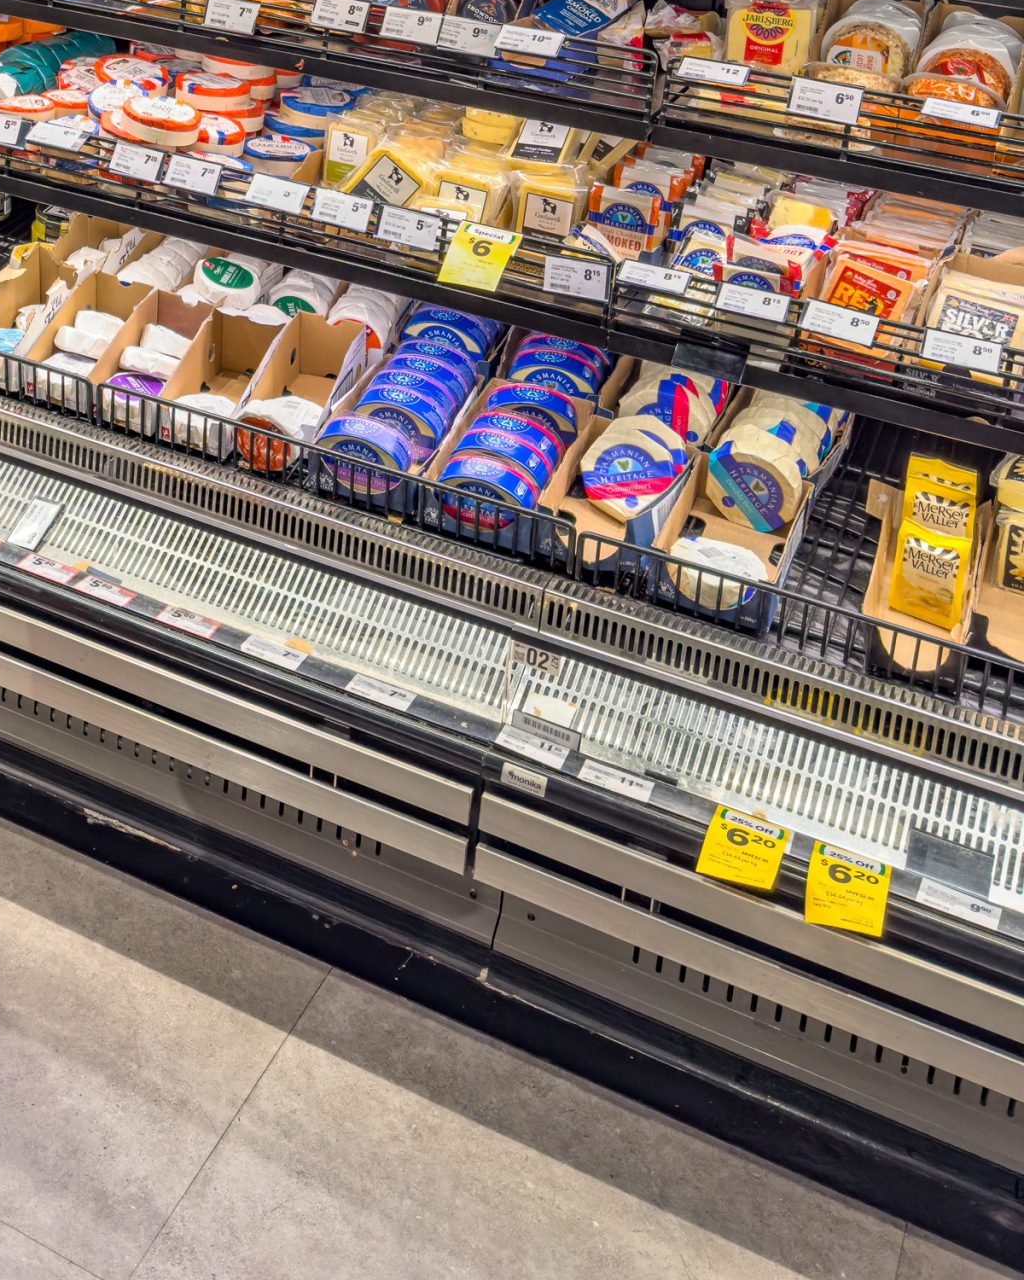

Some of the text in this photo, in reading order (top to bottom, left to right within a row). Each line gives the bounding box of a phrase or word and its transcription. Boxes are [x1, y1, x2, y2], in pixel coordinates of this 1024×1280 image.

[743, 13, 794, 27] JARLSBERG
[749, 45, 779, 54] ORIGINAL
[834, 92, 854, 105] 650
[606, 205, 642, 225] TASMANIAN
[474, 228, 504, 240] Special
[604, 219, 642, 233] HERITAGE
[469, 237, 493, 257] $6
[584, 269, 600, 281] 815
[945, 308, 1010, 338] SILVER
[972, 344, 993, 356] 850
[600, 449, 651, 475] TASMANIAN
[600, 470, 654, 483] HERITAGE
[730, 470, 768, 516] HERITAGE
[738, 467, 781, 511] TASMANIAN
[527, 647, 550, 671] 02
[511, 774, 542, 792] monika
[730, 815, 775, 836] 25% Off
[829, 850, 875, 871] 25% Off
